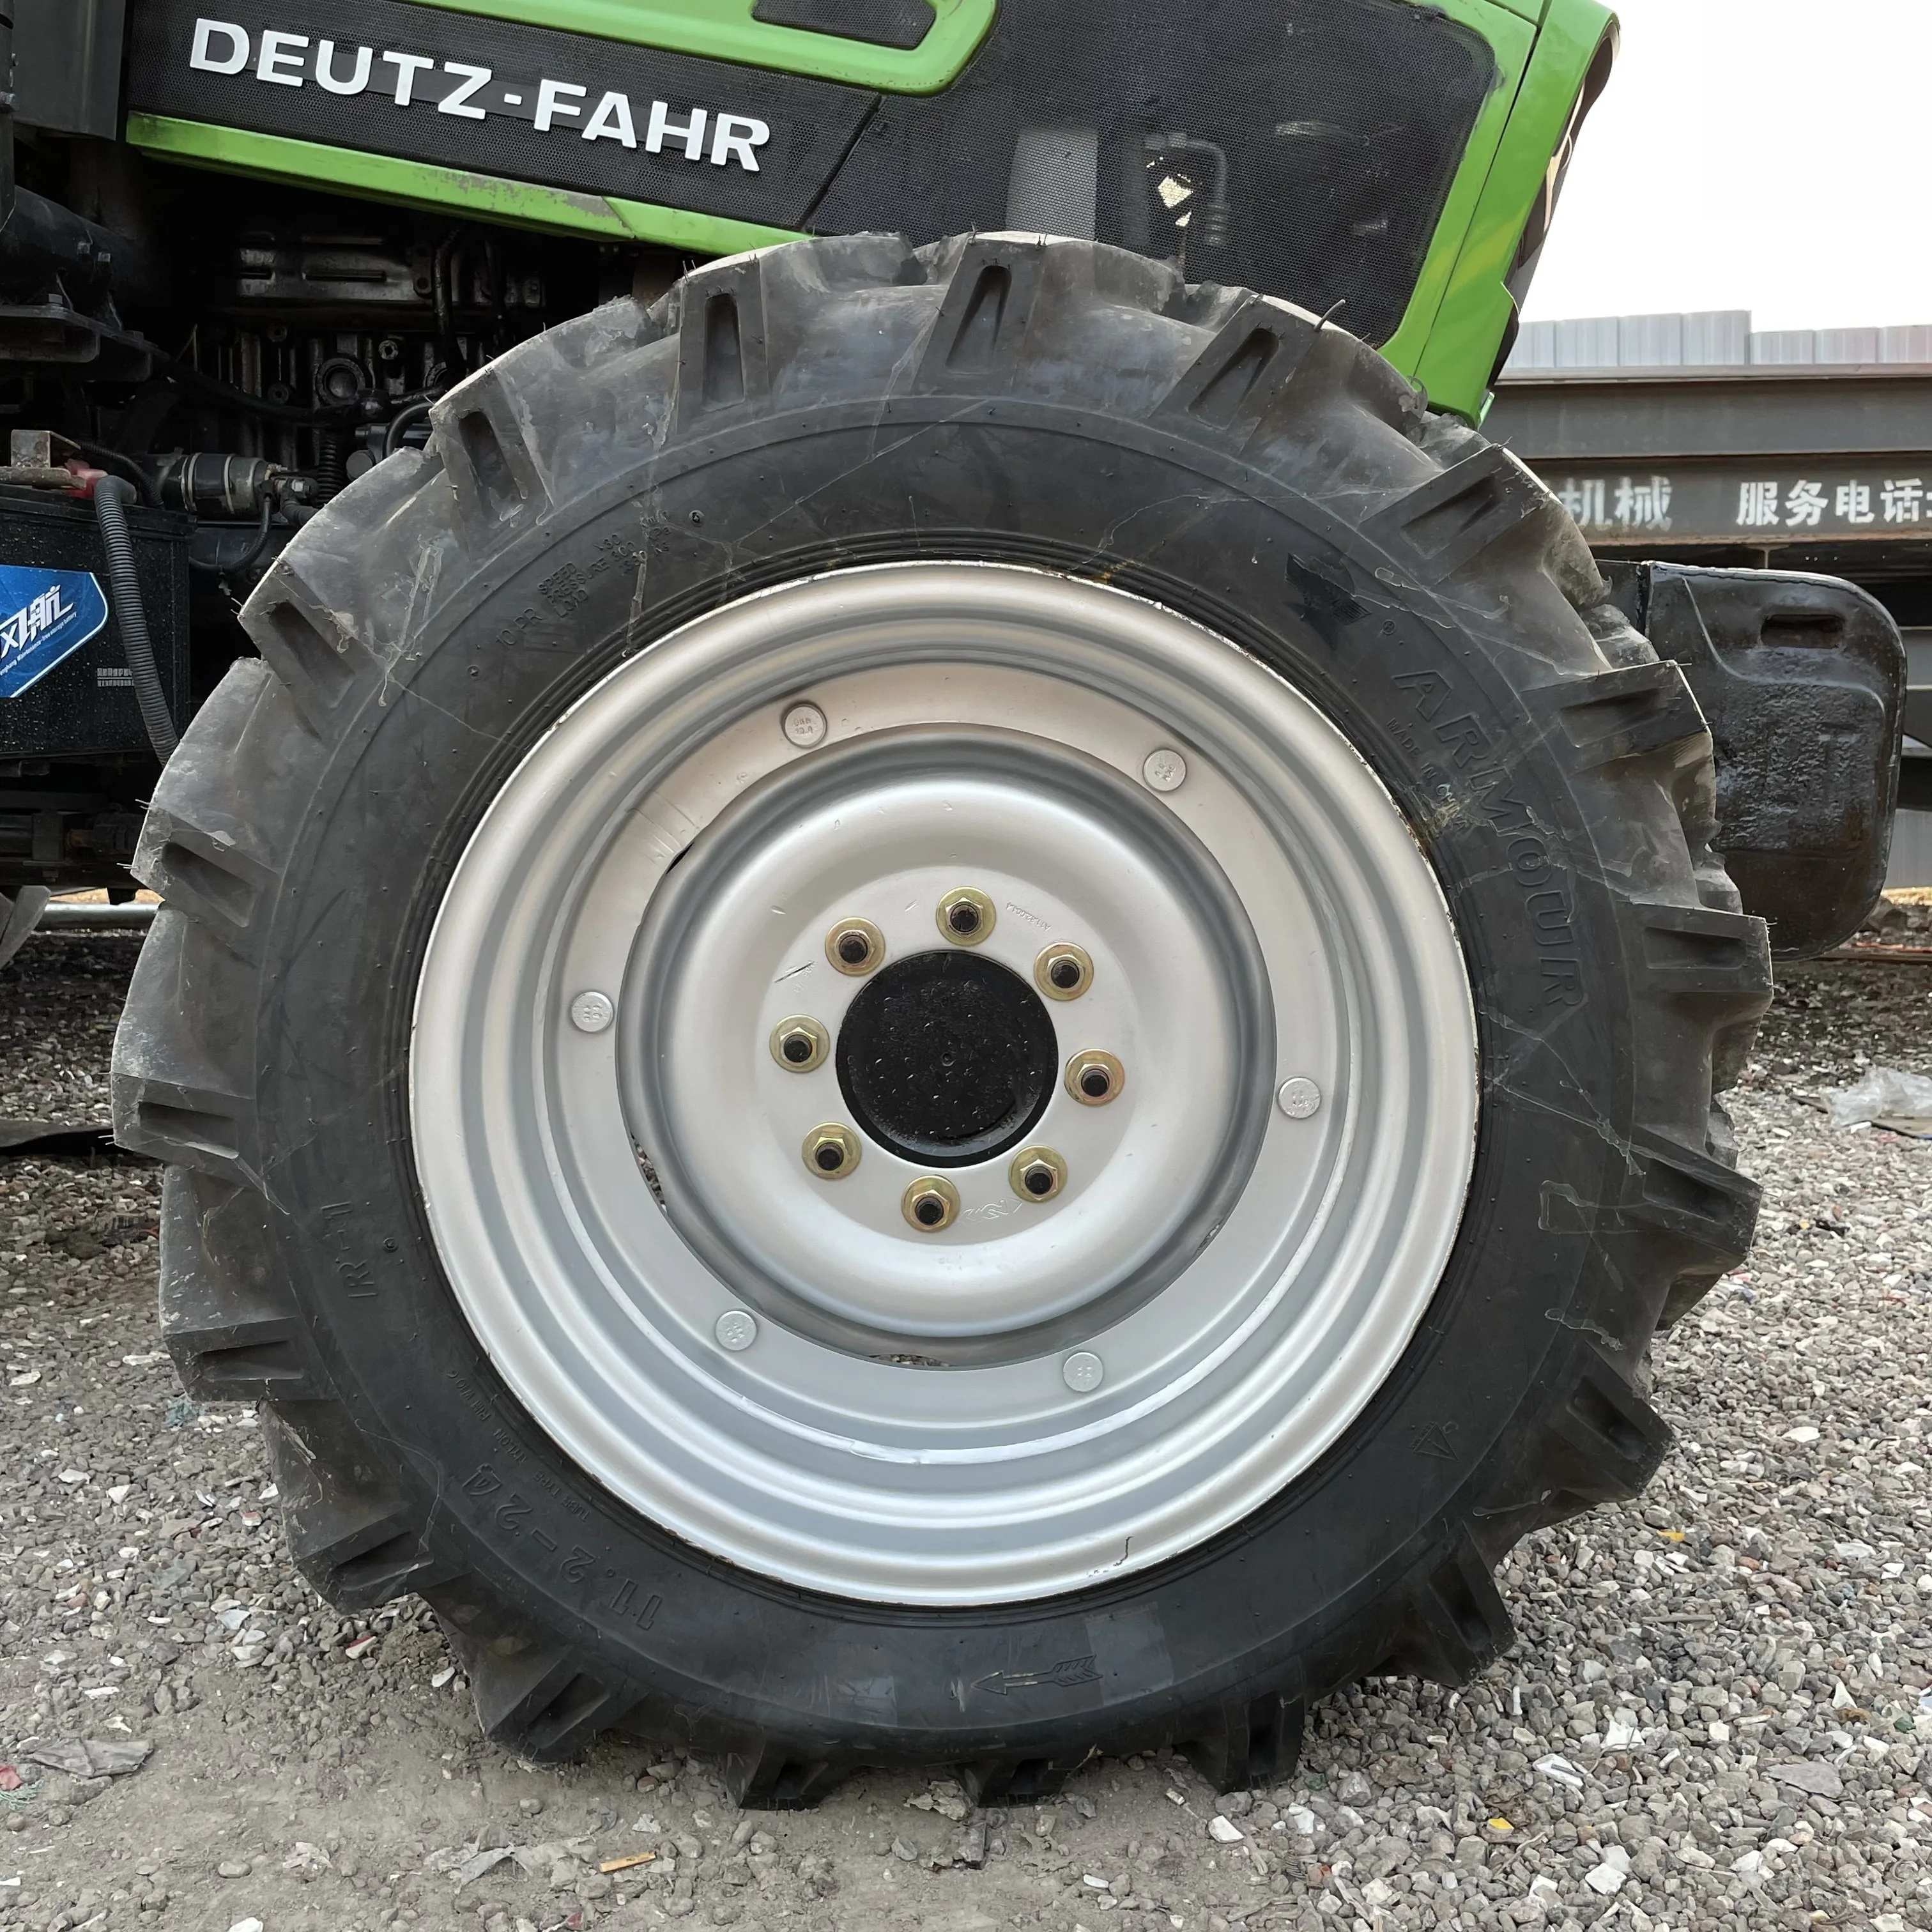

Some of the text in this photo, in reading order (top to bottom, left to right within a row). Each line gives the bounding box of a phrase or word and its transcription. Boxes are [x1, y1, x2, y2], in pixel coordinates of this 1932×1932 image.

[189, 17, 770, 172] DEUTZ-FAHR
[1558, 475, 1673, 532] 机械
[1386, 717, 1422, 759] MADE
[1421, 762, 1438, 780] IN
[1390, 668, 1590, 1007] ARMOUR
[461, 1462, 663, 1631] 11.2-24
